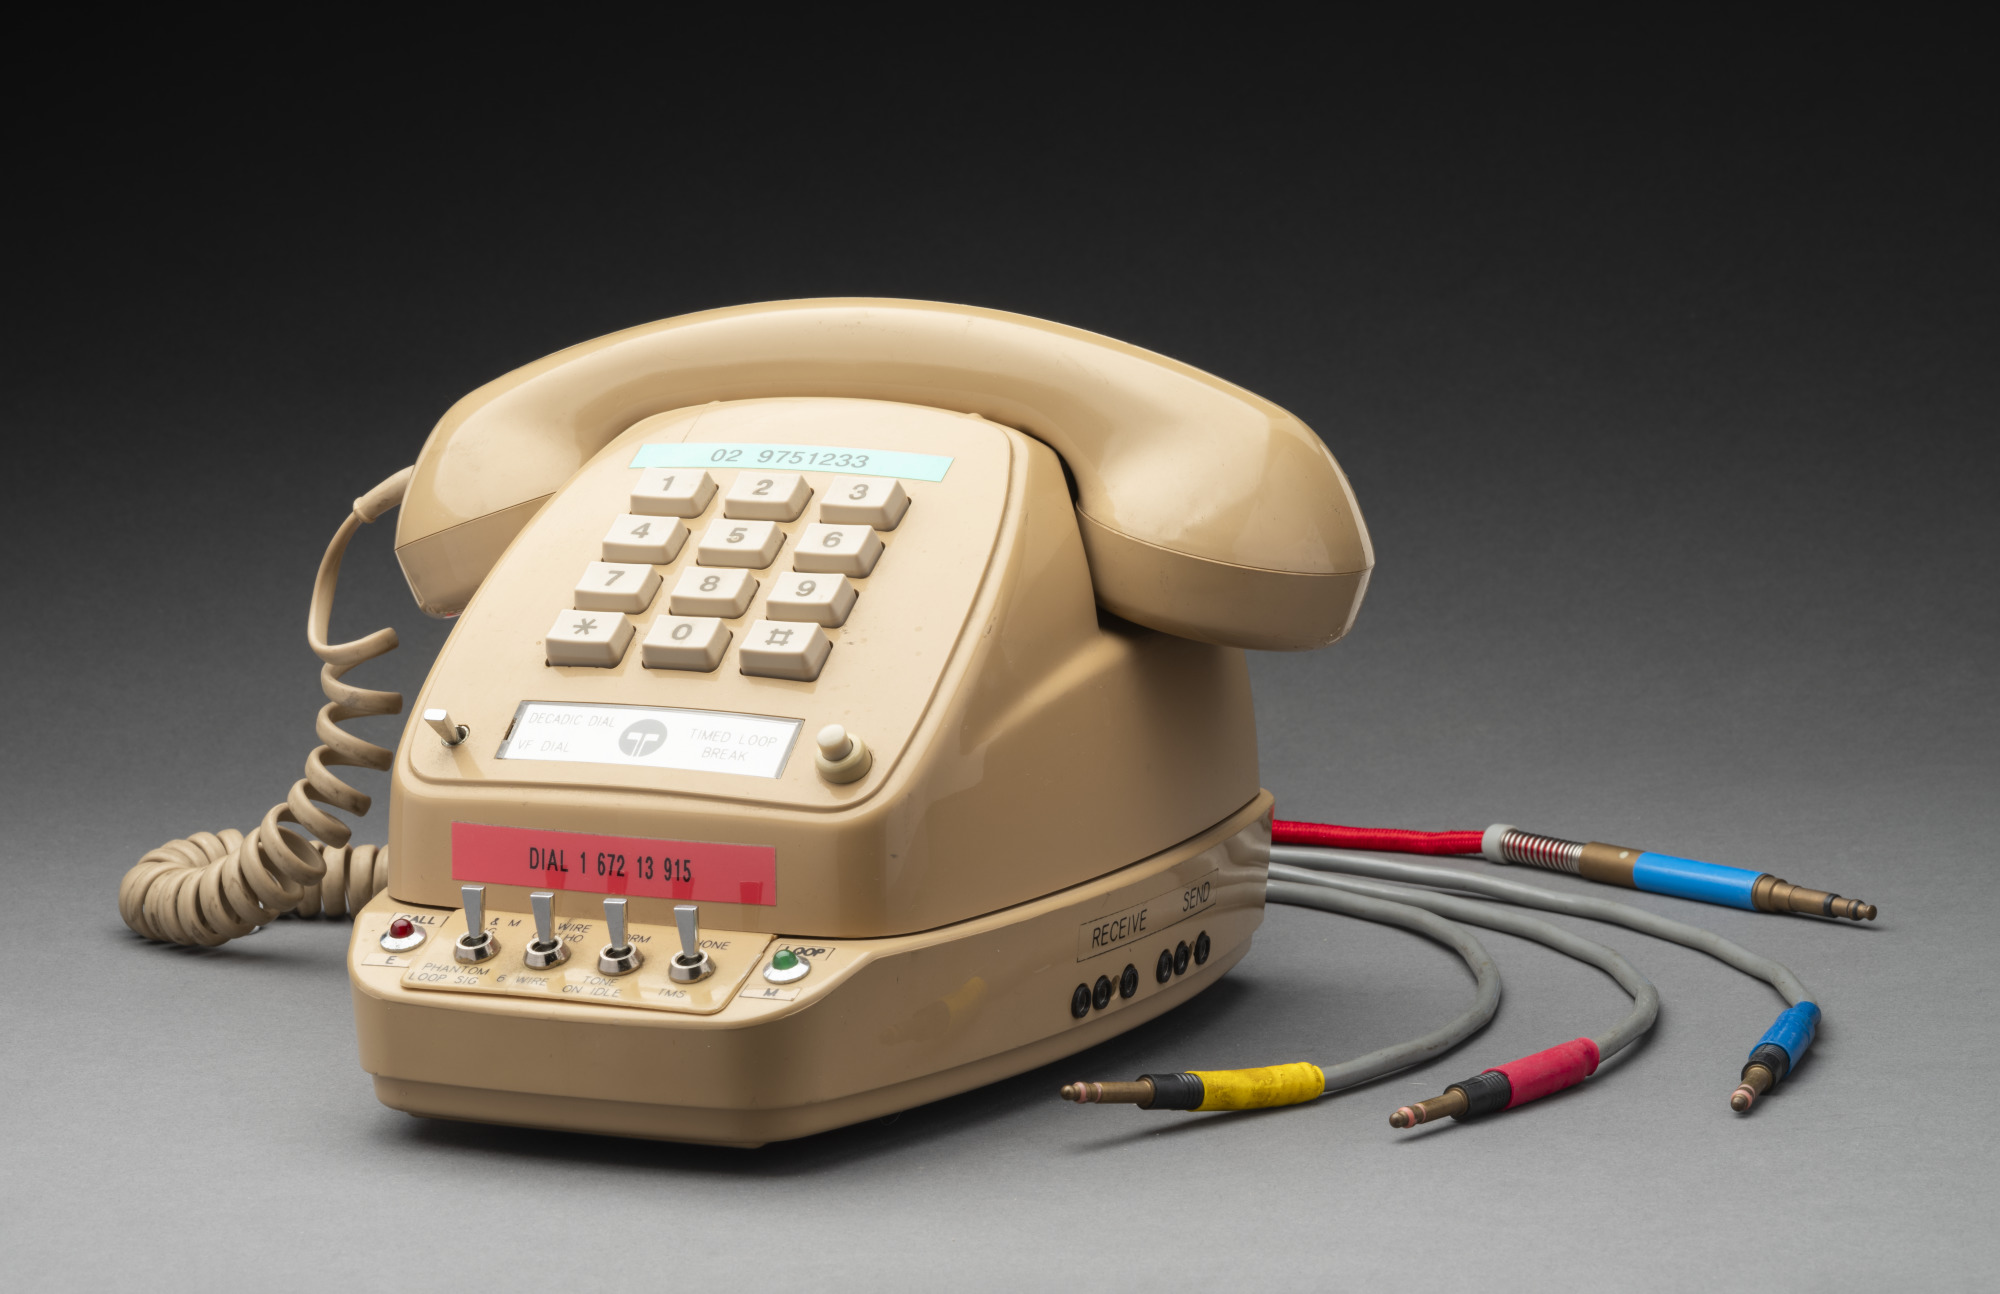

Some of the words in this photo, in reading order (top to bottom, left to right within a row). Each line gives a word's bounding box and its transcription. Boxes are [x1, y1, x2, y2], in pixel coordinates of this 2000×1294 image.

[710, 448, 743, 463] 02
[757, 449, 870, 469] 9751233
[661, 475, 676, 492] 1
[752, 479, 774, 496] 2
[848, 484, 869, 500] 3
[630, 523, 651, 539] 4
[726, 527, 748, 543] 5
[821, 531, 844, 549] 6
[605, 570, 625, 586] 7
[699, 575, 721, 592] 8
[795, 580, 817, 597] 9
[671, 623, 693, 641] 0
[528, 712, 583, 726] DECADIC
[588, 715, 615, 728] DIAL
[690, 728, 731, 743] TIMED
[738, 734, 777, 748] LOOP
[517, 740, 533, 750] VF
[541, 741, 569, 753] DIAL
[702, 746, 748, 761] BREAK
[529, 847, 569, 872] DIAL
[580, 851, 586, 873] 1
[598, 852, 625, 877] 672
[637, 856, 654, 880] 13
[664, 857, 691, 882] 915
[507, 919, 521, 927] M
[1092, 908, 1148, 949] RECEIVE
[1183, 881, 1211, 912] SEND
[557, 922, 592, 934] WIRE
[385, 955, 397, 965] E
[422, 962, 490, 976] PHANTOM
[408, 972, 447, 982] LOOP
[454, 976, 479, 985] SIG
[496, 974, 507, 983] 6
[515, 976, 550, 987] WIRE
[584, 975, 619, 987] TONE
[562, 984, 583, 994] ON
[590, 987, 623, 998] IDLE
[658, 988, 687, 999] TMS
[763, 987, 780, 997] M
